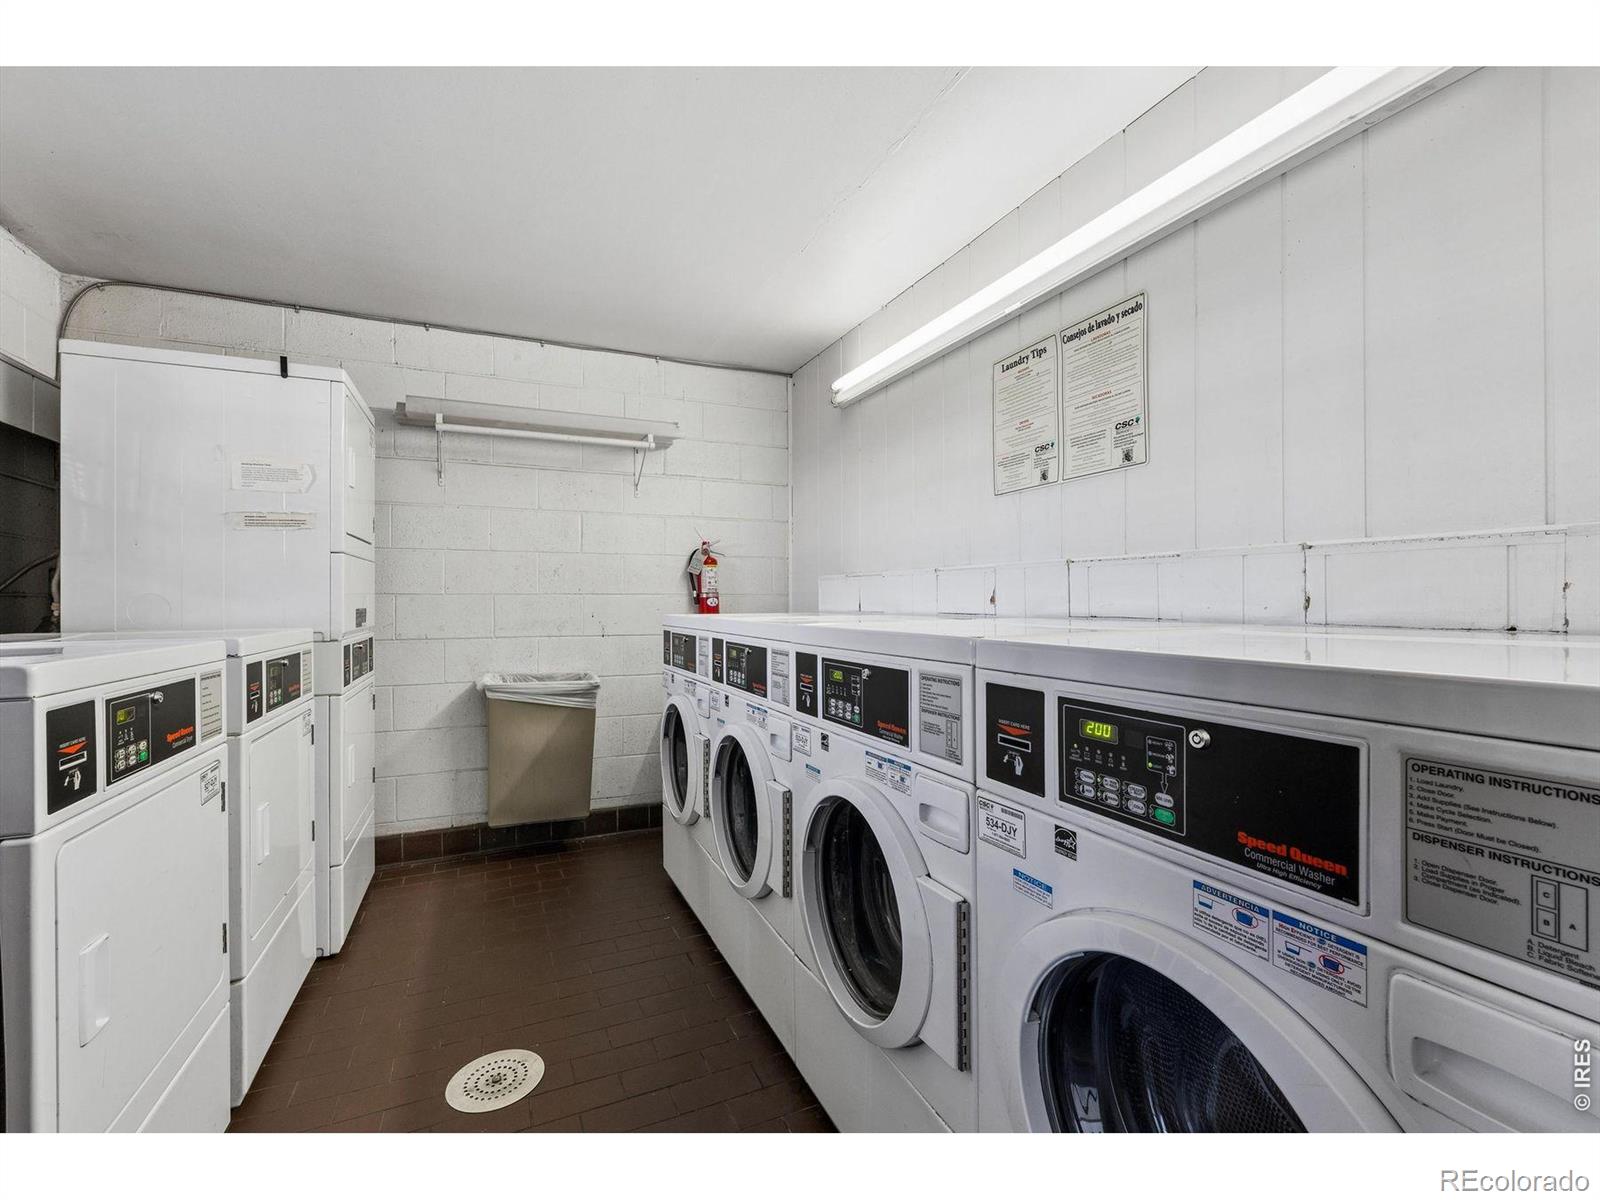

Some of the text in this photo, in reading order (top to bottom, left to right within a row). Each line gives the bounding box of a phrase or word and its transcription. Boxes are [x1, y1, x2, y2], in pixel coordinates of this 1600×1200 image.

[1062, 301, 1143, 345] Consejos de lavado y secado
[1001, 354, 1030, 374] Laundry
[1030, 345, 1048, 360] Tips
[1115, 418, 1134, 431] CSC
[1034, 443, 1050, 453] CSC
[1086, 722, 1111, 738] 200
[1411, 763, 1600, 806] OPERATING INSTRUCTIONS
[1416, 778, 1434, 787] Load
[1417, 786, 1436, 795] Close
[1416, 802, 1435, 811] Make
[1436, 806, 1455, 816] Cycle
[1416, 811, 1435, 820] Make
[1417, 794, 1431, 802] Add
[1431, 797, 1462, 809] Supplies
[1463, 804, 1480, 812] (See
[1481, 808, 1526, 822] Instructions
[985, 816, 1018, 838] 534-DJY
[1416, 818, 1435, 828] Press
[1437, 823, 1453, 833] Start
[1476, 832, 1495, 842] Must
[1496, 837, 1506, 845] be
[1237, 831, 1348, 877] Speed Queen
[1412, 831, 1600, 887] DISPENSER INSTRUCTIONS
[1244, 847, 1336, 886] Commercial Washer
[1256, 862, 1322, 890] Ultra High Efficiency
[1421, 860, 1440, 870] Open
[1441, 865, 1477, 880] Dispenser
[1421, 865, 1439, 875] Load
[1439, 871, 1470, 885] Supplies
[1480, 882, 1505, 894] Proper
[1421, 878, 1441, 888] Close
[1200, 884, 1260, 913] ADVERTENCIA
[1542, 891, 1550, 899] C
[1298, 921, 1338, 942] NOTICE
[1543, 918, 1550, 927] B
[1569, 923, 1577, 931] A
[1537, 941, 1580, 960] Detergent
[1537, 948, 1563, 962] Liquid
[1538, 954, 1565, 969] Fabric
